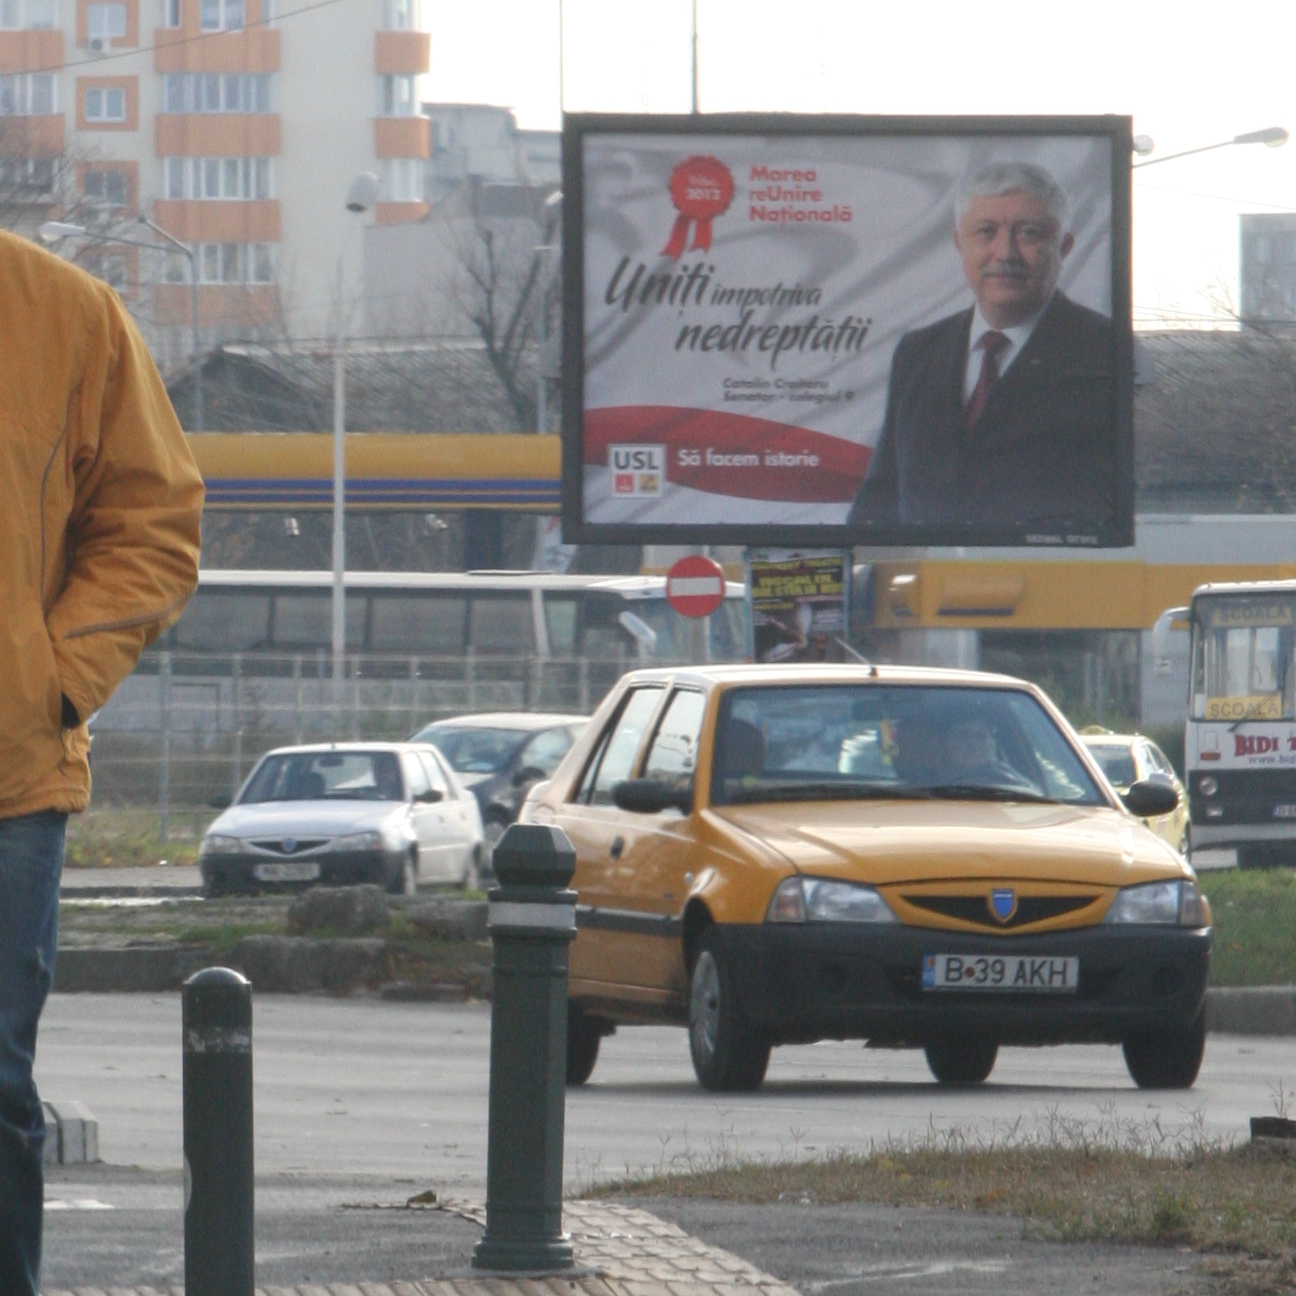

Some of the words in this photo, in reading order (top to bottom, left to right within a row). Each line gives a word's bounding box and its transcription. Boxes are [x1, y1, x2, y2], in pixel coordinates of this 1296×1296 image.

[749, 166, 817, 182] Marea
[749, 185, 822, 202] reUnire
[613, 450, 660, 471] USL
[706, 448, 760, 467] facem
[765, 449, 821, 467] istorie
[1234, 734, 1279, 757] BIDI
[1014, 959, 1068, 985] AKH
